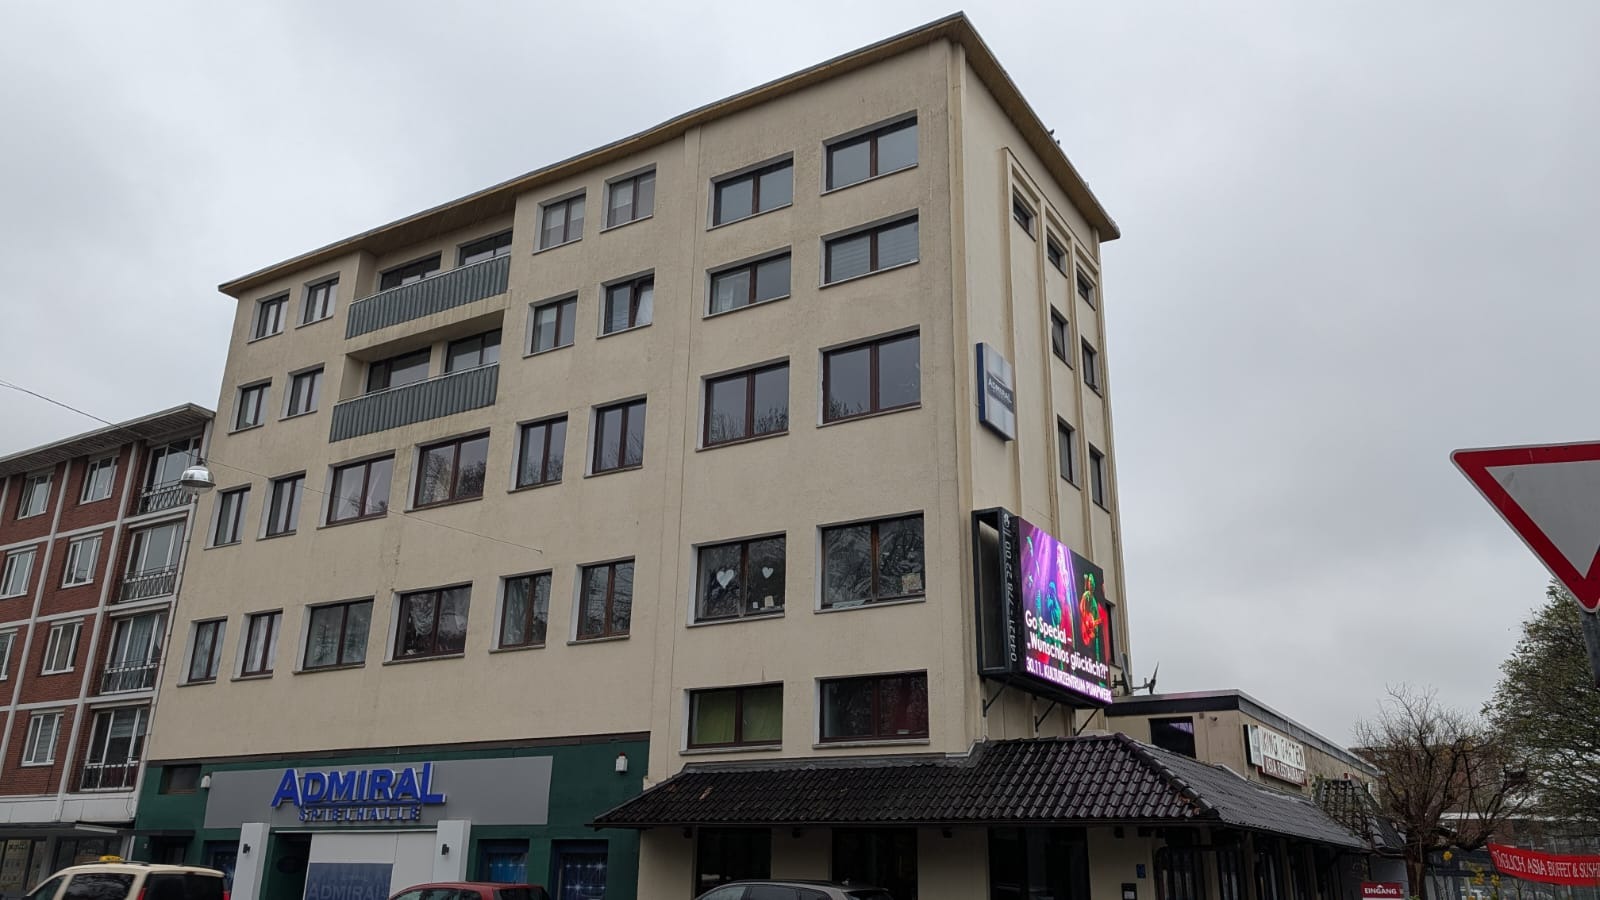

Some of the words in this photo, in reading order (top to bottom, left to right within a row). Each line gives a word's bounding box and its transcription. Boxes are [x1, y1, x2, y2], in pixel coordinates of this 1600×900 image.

[1025, 610, 1037, 629] Go
[1038, 616, 1067, 645] Special
[1026, 656, 1044, 677] 30.11.
[1043, 664, 1086, 692] KULTURZENTRUM
[271, 762, 447, 807] ADMIRAL
[298, 805, 422, 822] SPIELHALLE
[1492, 850, 1526, 872] TÄGLICH
[1527, 858, 1547, 875] ASIA
[1547, 861, 1572, 877] BUFFET
[1572, 863, 1579, 877] &
[1364, 887, 1397, 895] EINGANG
